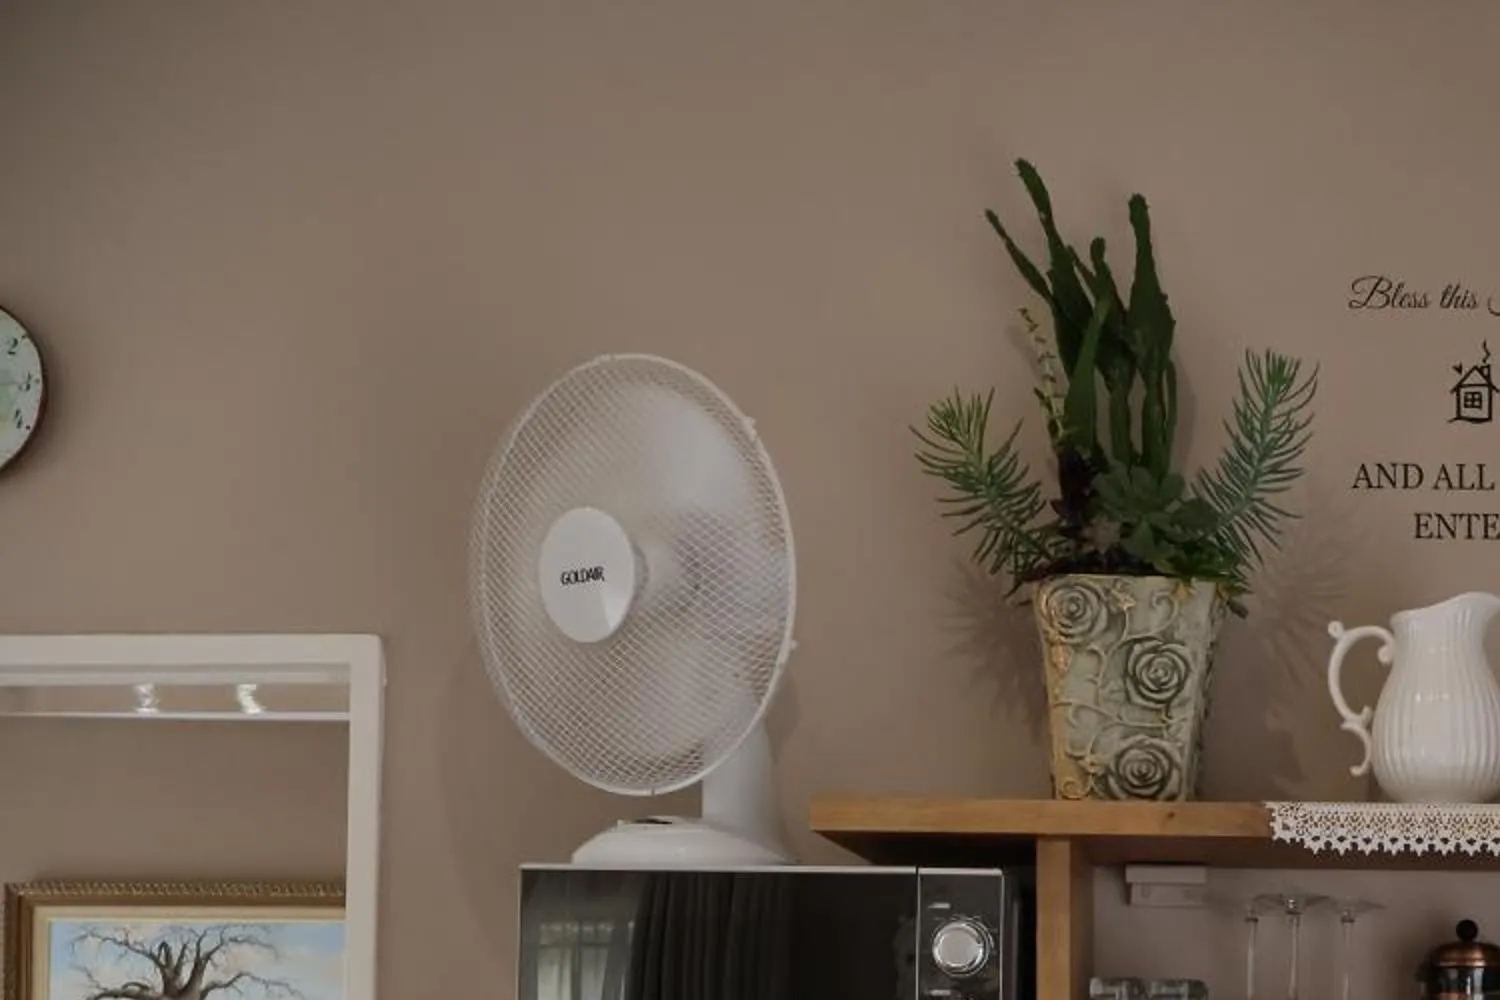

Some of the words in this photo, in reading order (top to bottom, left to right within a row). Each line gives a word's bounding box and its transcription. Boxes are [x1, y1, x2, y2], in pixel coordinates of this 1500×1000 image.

[1348, 275, 1431, 310] Bless
[1439, 282, 1479, 311] this
[1352, 463, 1425, 490] AND
[1432, 463, 1496, 491] ALL
